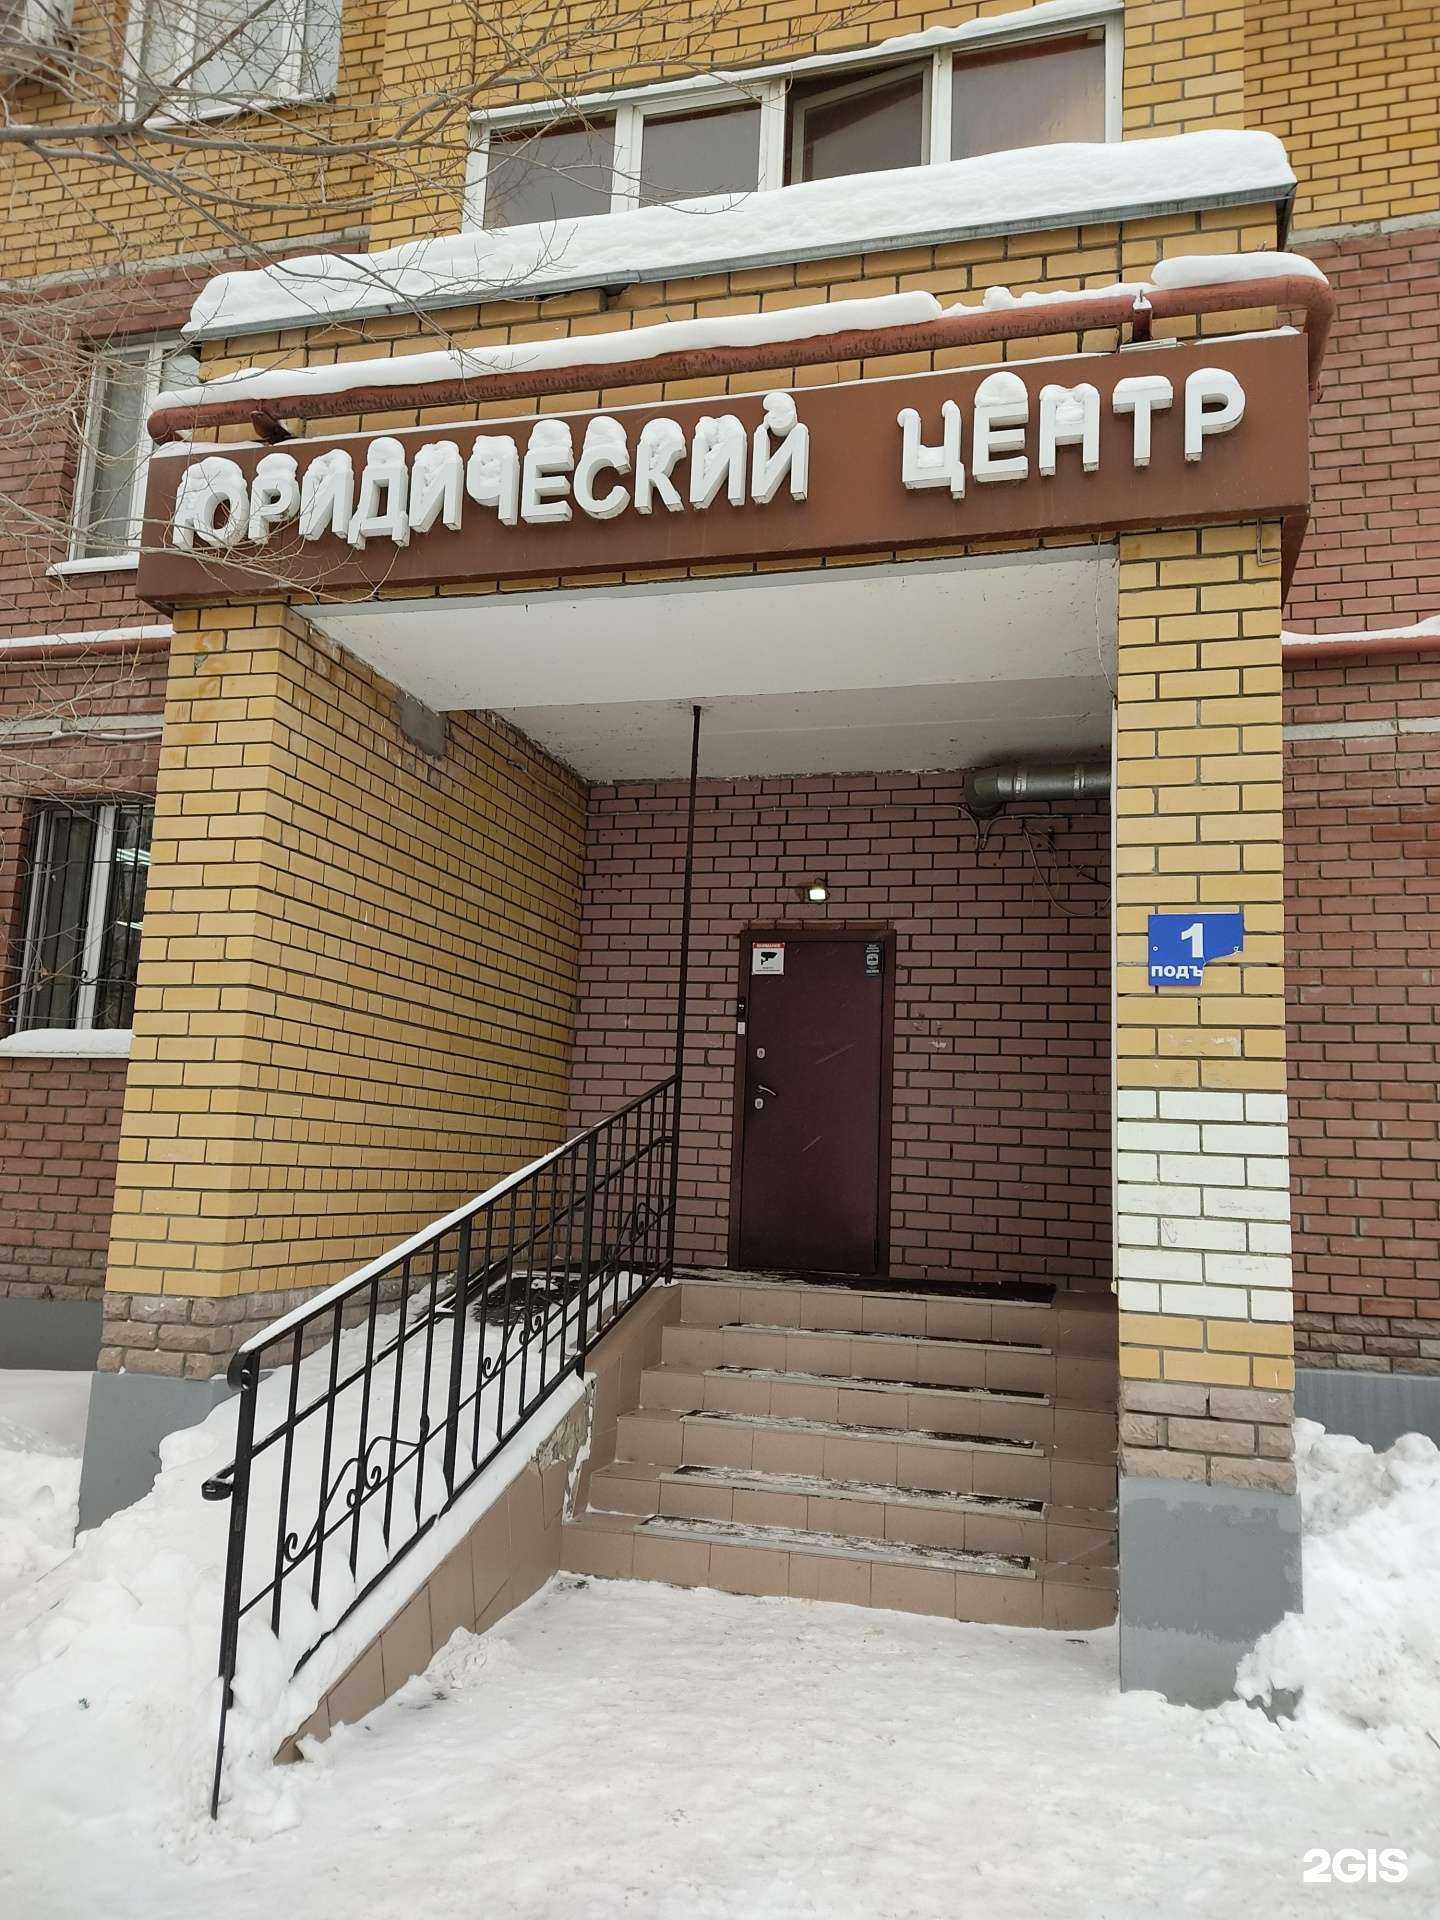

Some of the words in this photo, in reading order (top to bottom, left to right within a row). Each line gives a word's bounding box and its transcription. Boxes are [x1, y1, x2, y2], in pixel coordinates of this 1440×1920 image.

[172, 393, 809, 550] ЮРИДИЧЕСКИЙ
[898, 369, 1246, 499] ЦЕНТР
[1181, 923, 1203, 958] 1
